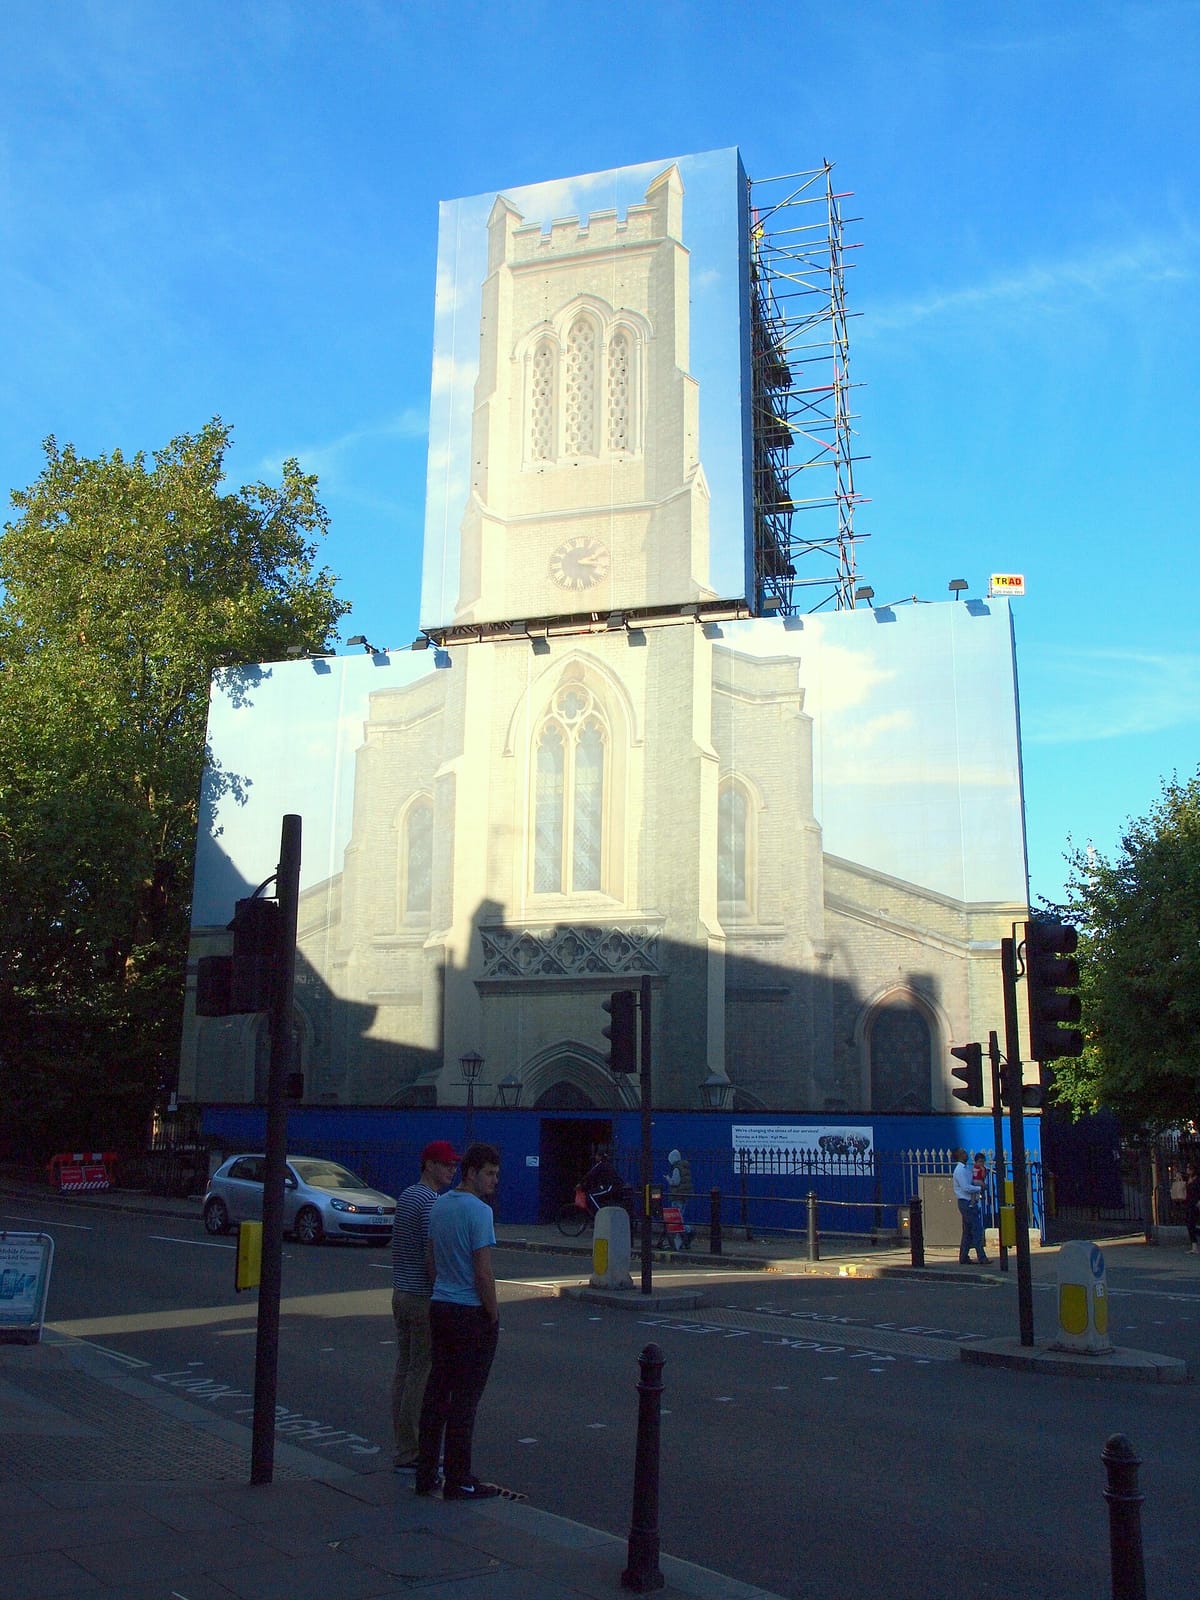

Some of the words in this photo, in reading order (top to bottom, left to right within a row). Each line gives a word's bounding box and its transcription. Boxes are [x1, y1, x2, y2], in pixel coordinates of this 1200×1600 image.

[995, 577, 1022, 585] TRAD
[636, 1319, 750, 1338] LEFT
[768, 1309, 865, 1323] LOOK
[873, 1322, 987, 1340] LEFT
[762, 1338, 876, 1358] LOOK
[151, 1371, 253, 1400] LOOK
